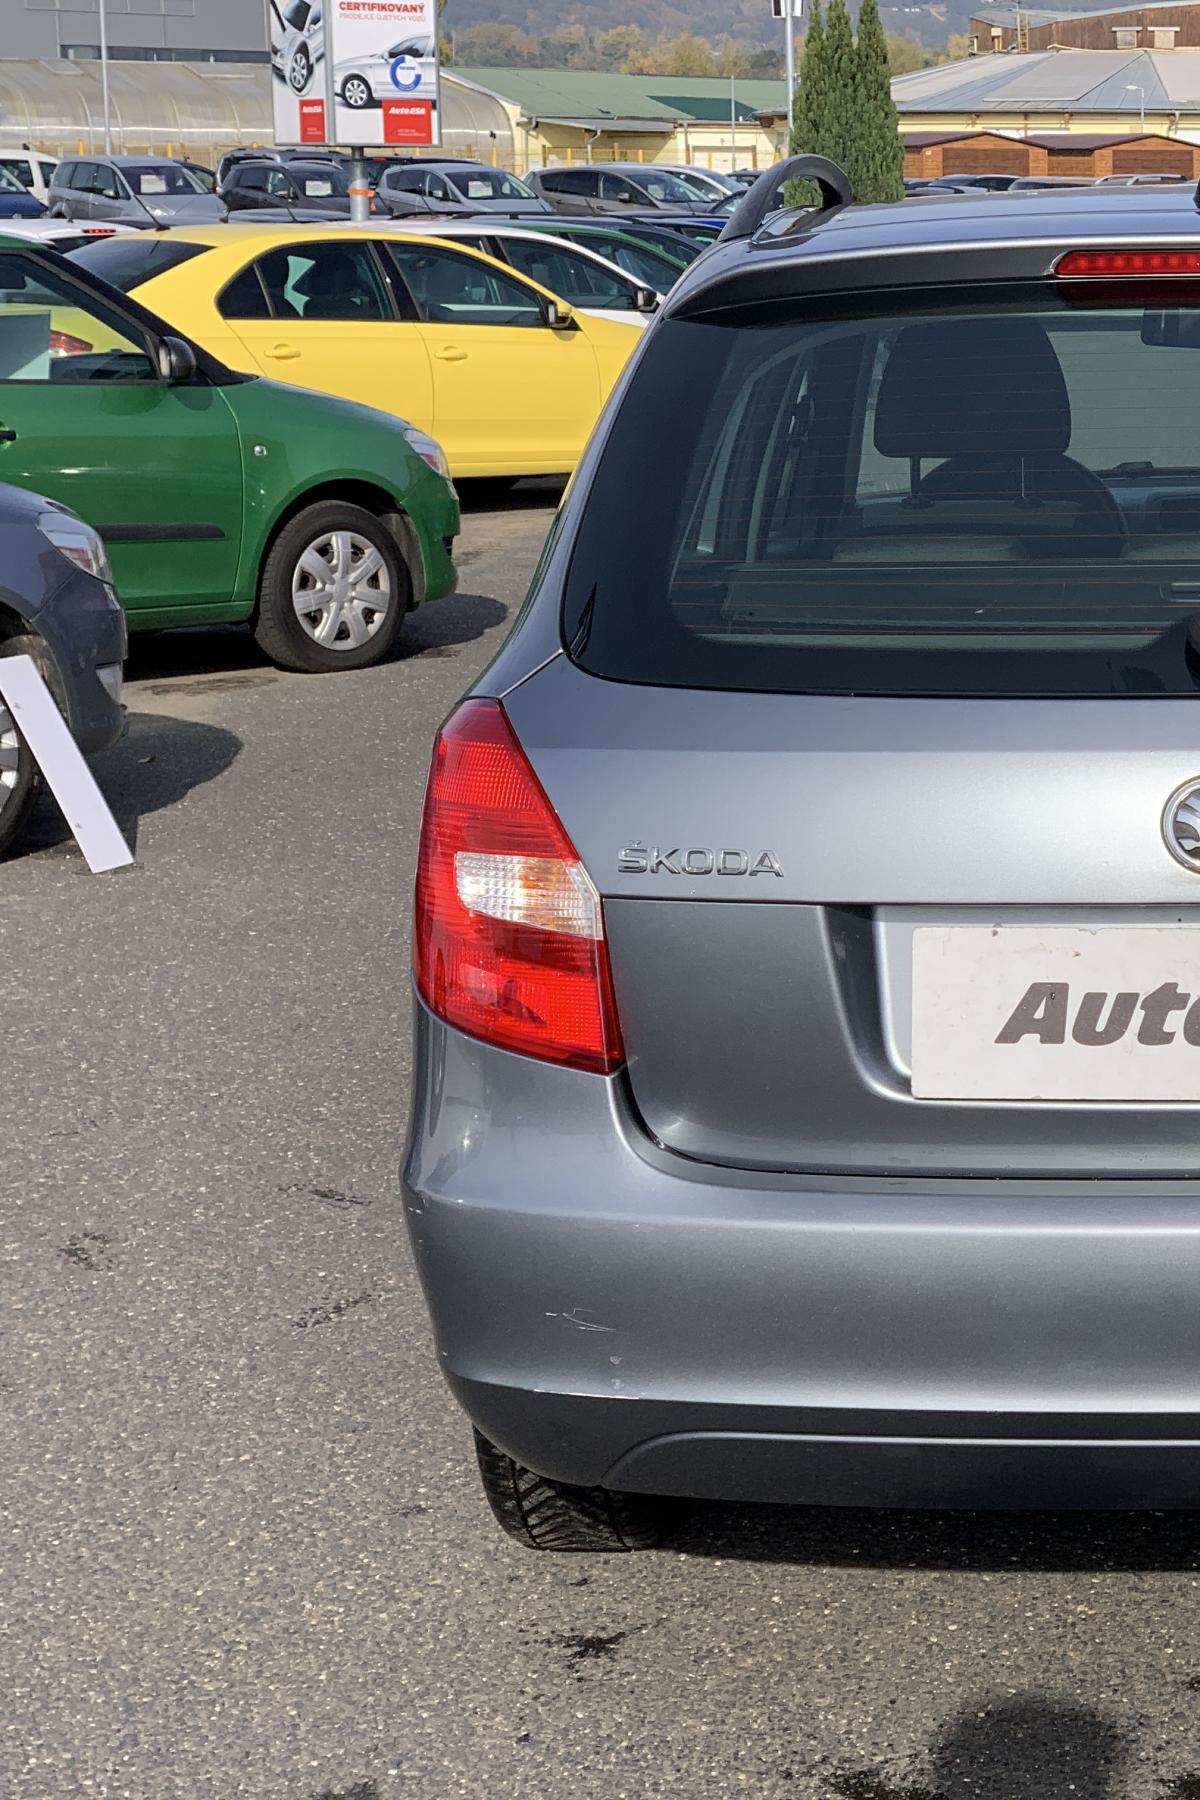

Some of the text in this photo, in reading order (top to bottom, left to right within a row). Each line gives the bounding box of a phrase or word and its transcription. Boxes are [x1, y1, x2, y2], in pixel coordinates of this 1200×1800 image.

[338, 2, 425, 13] CERTIFIKOVANÝ
[388, 107, 427, 115] Auto ESA
[618, 839, 784, 877] ŠKODA
